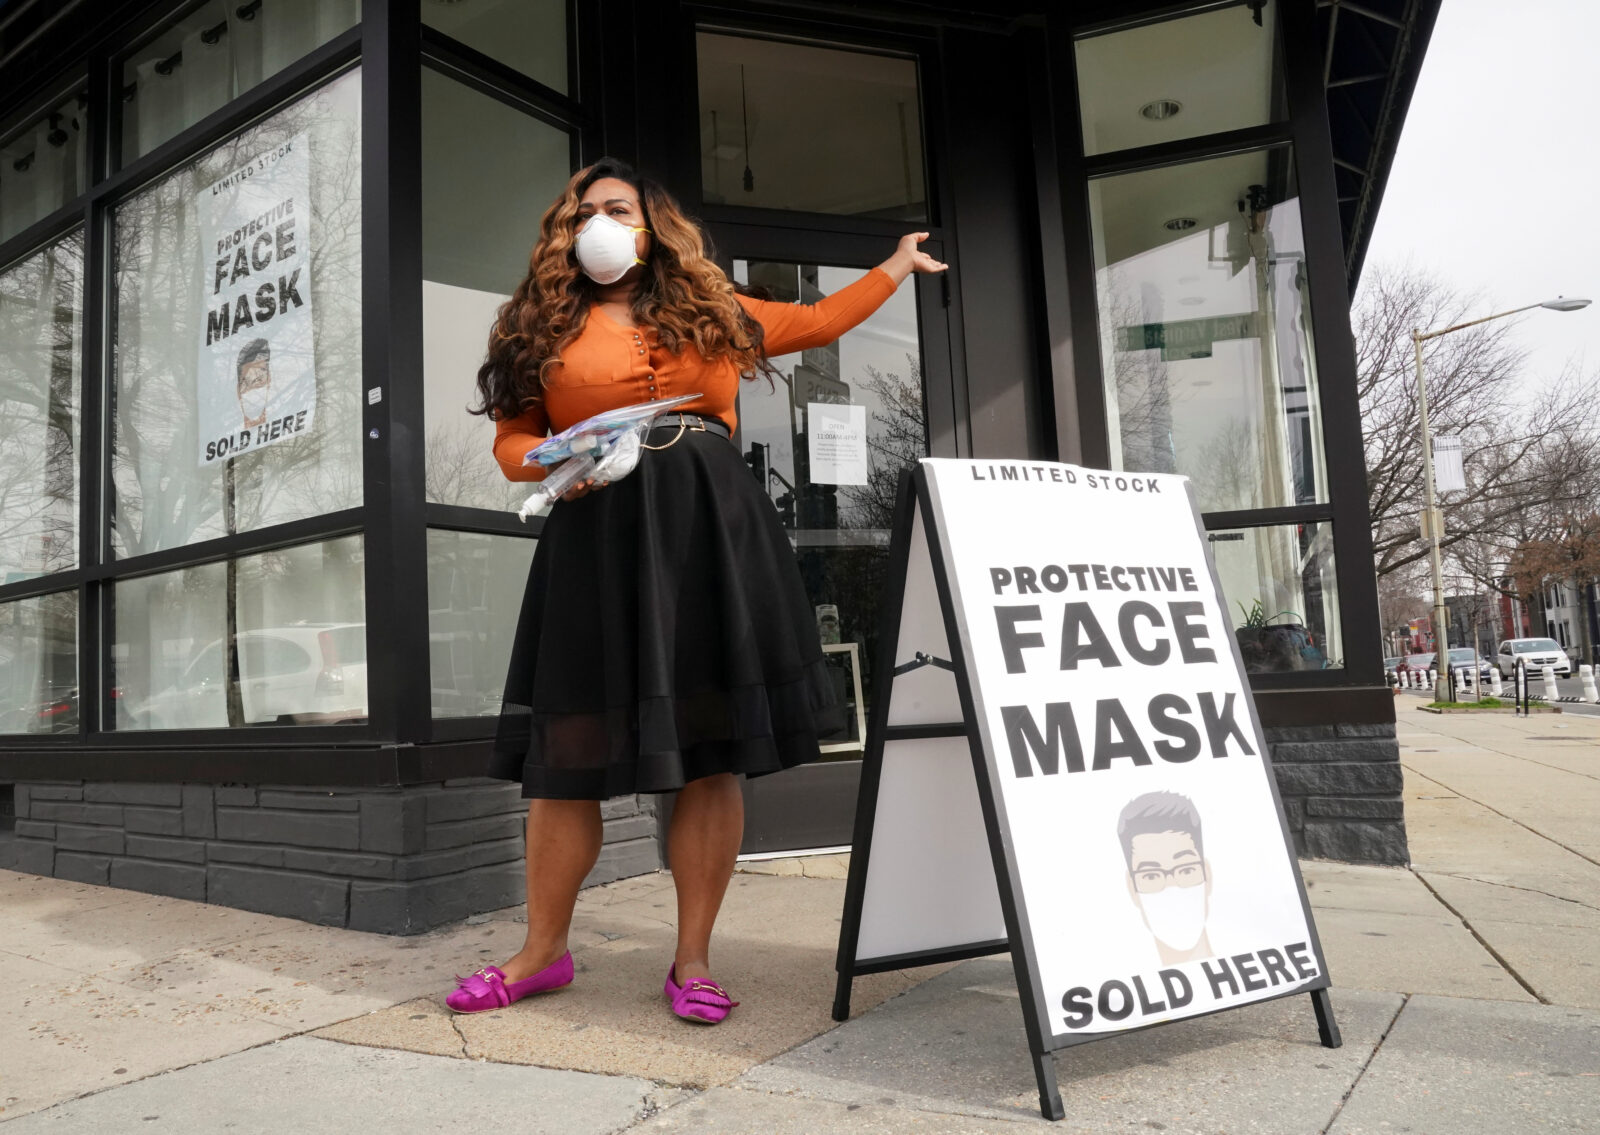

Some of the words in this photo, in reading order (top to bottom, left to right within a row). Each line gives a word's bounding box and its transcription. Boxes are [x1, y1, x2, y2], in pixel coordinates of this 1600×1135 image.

[212, 166, 254, 196] LIMITED
[258, 142, 293, 170] STOCK
[214, 217, 297, 296] FACE
[217, 198, 294, 256] PROTECTIVE
[206, 268, 304, 347] MASK
[206, 430, 251, 461] SOLD
[256, 410, 308, 445] HERE
[971, 465, 1078, 485] LIMITED
[1086, 474, 1161, 493] STOCK
[989, 563, 1199, 595] PROTECTIVE
[993, 600, 1218, 674] FACE
[1000, 692, 1256, 778] MASK
[1061, 968, 1194, 1029] SOLD
[1200, 942, 1317, 999] HERE
